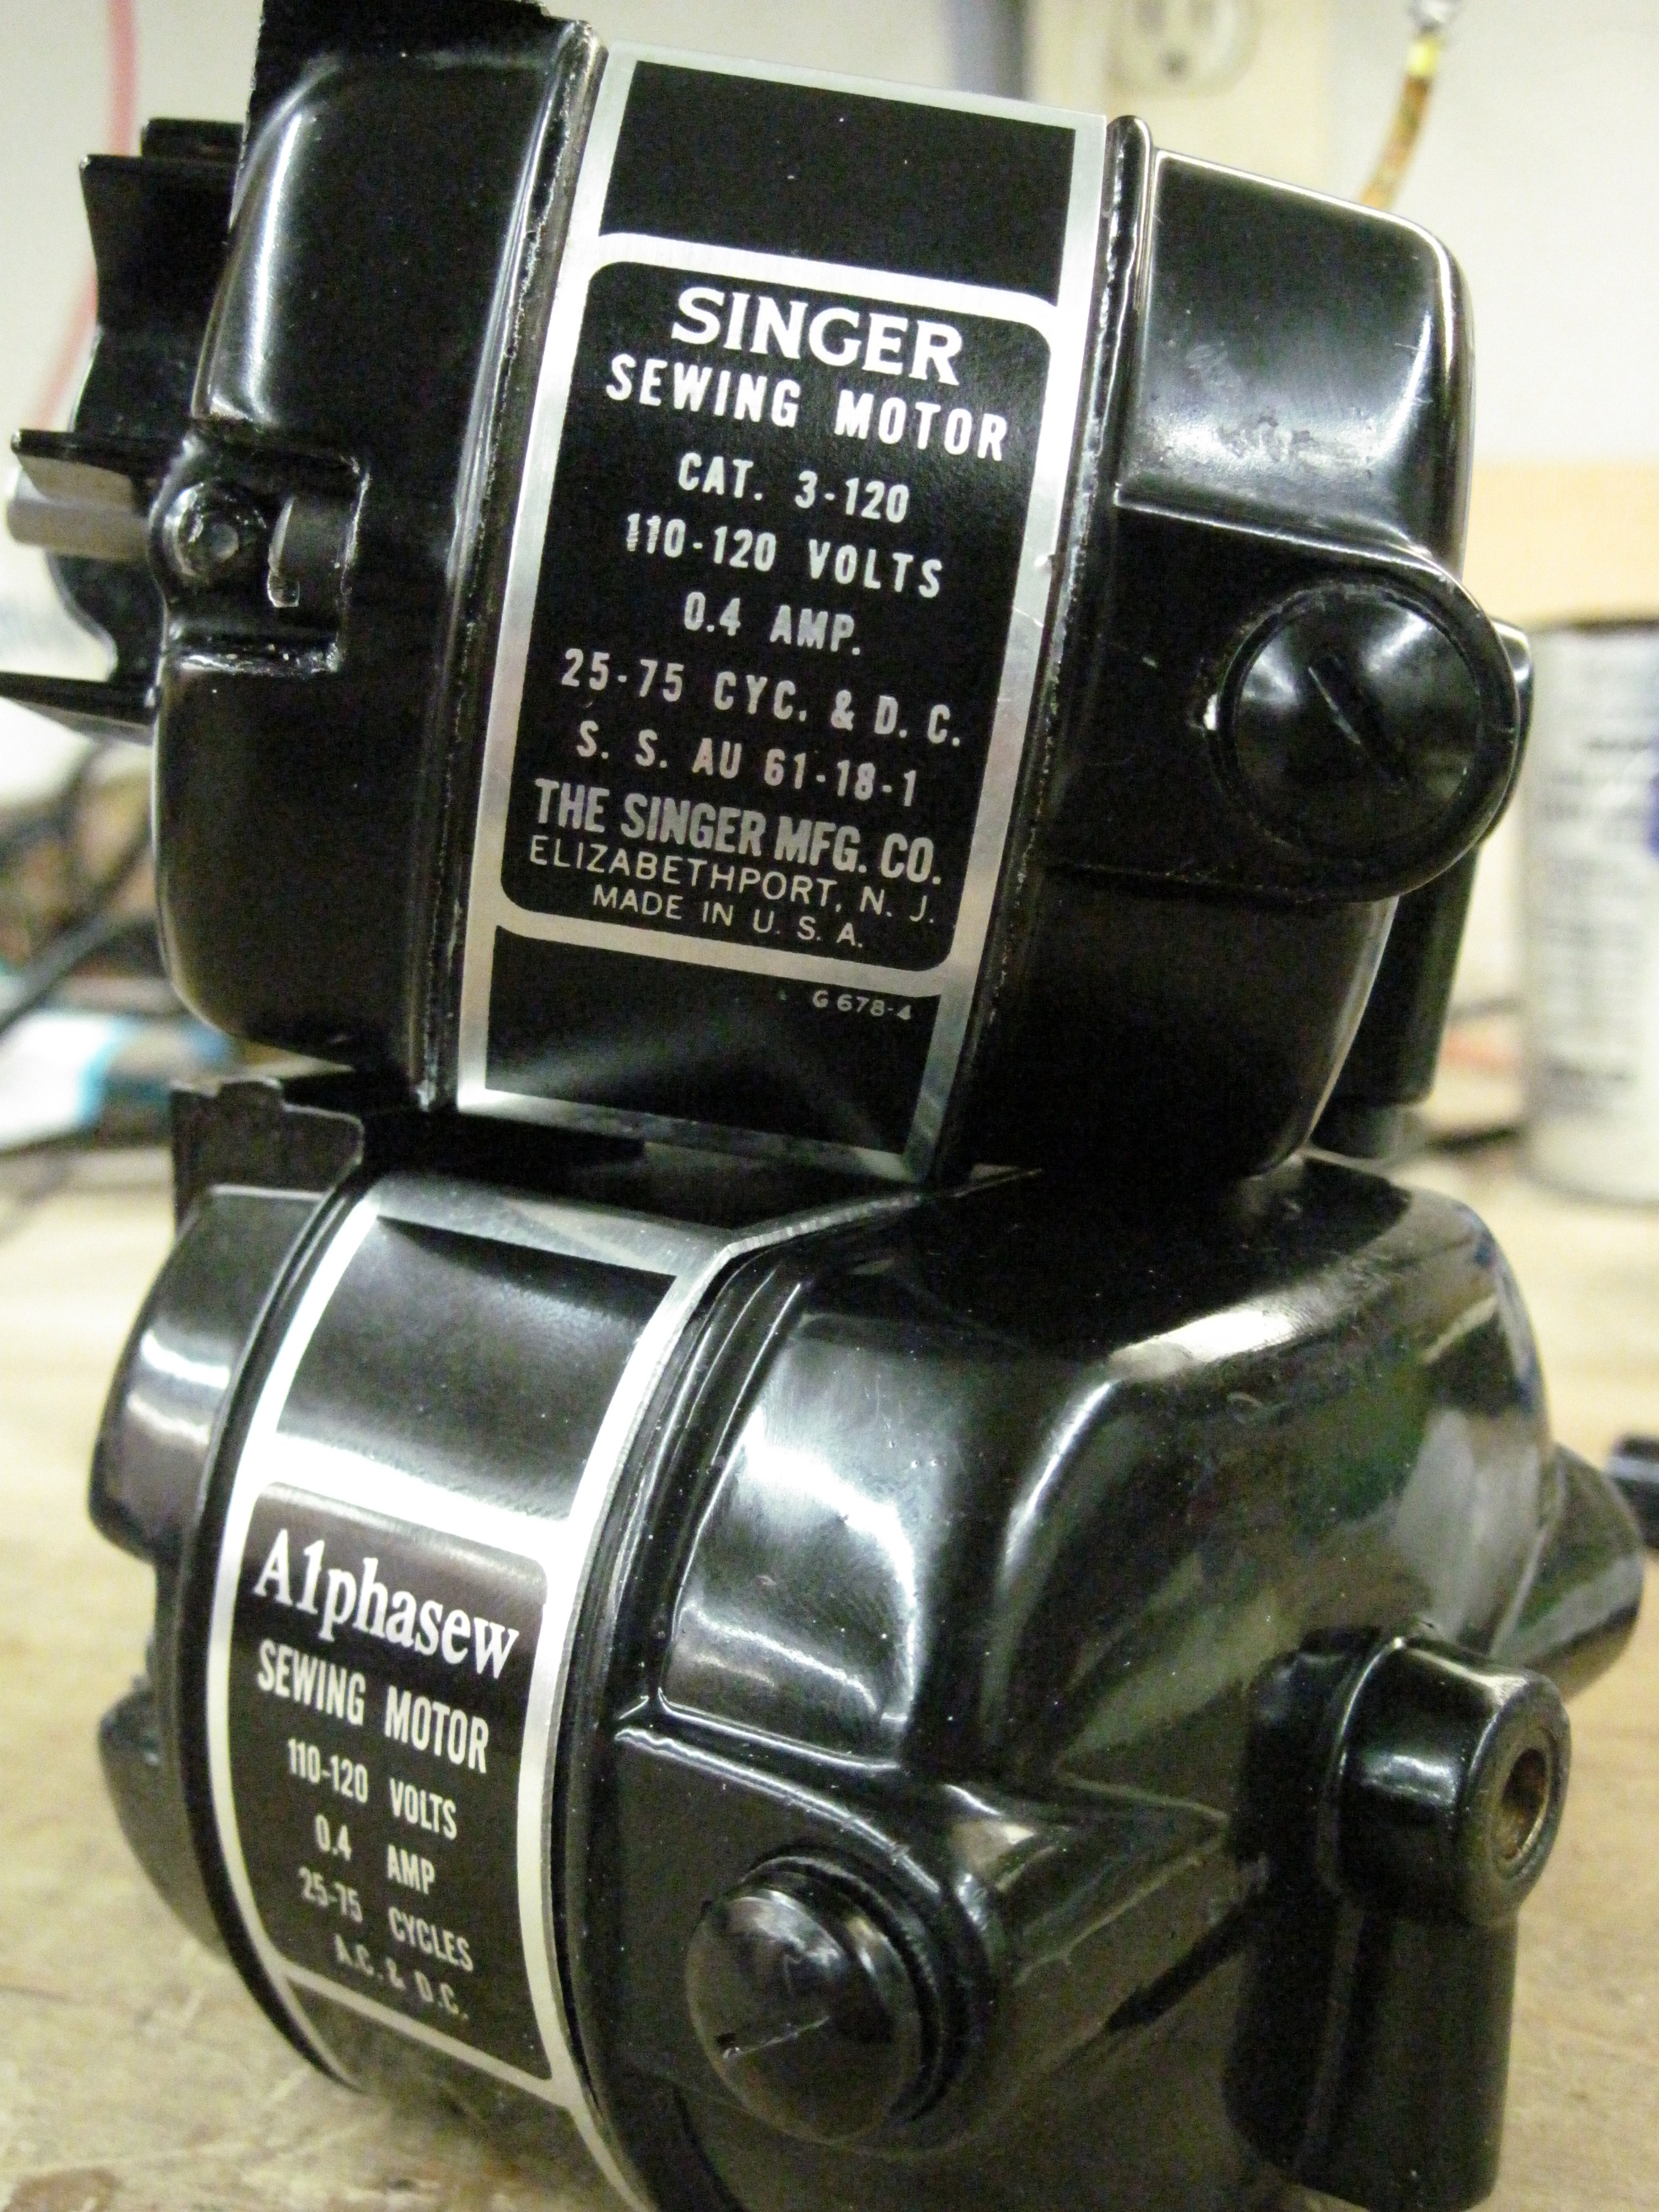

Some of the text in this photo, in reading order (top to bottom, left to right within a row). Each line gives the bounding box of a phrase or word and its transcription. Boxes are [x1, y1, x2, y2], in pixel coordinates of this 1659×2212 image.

[671, 287, 963, 385] SINGER
[606, 354, 1009, 461] SEWING MOTOR
[678, 452, 909, 523] CAT. 3-120
[626, 513, 942, 598] 110-120 VOLTS
[684, 591, 861, 655] 0.4 AMP.
[561, 648, 685, 702] 25-75
[714, 672, 807, 722] CYC.
[830, 690, 854, 729] &
[692, 738, 742, 779] AU
[765, 749, 917, 807] 61-18-1
[535, 778, 941, 884] THE SINGER MFG. CO.
[529, 836, 842, 912] ELIZABETHPORT,
[593, 885, 682, 920] MADE
[702, 901, 733, 926] IN
[258, 1638, 489, 1773] SEWING MOTOR
[288, 1738, 457, 1839] 110-120 VOLTS
[315, 1814, 435, 1895] 0.4 AMP
[299, 1866, 473, 1972] 25-75 CYCLES
